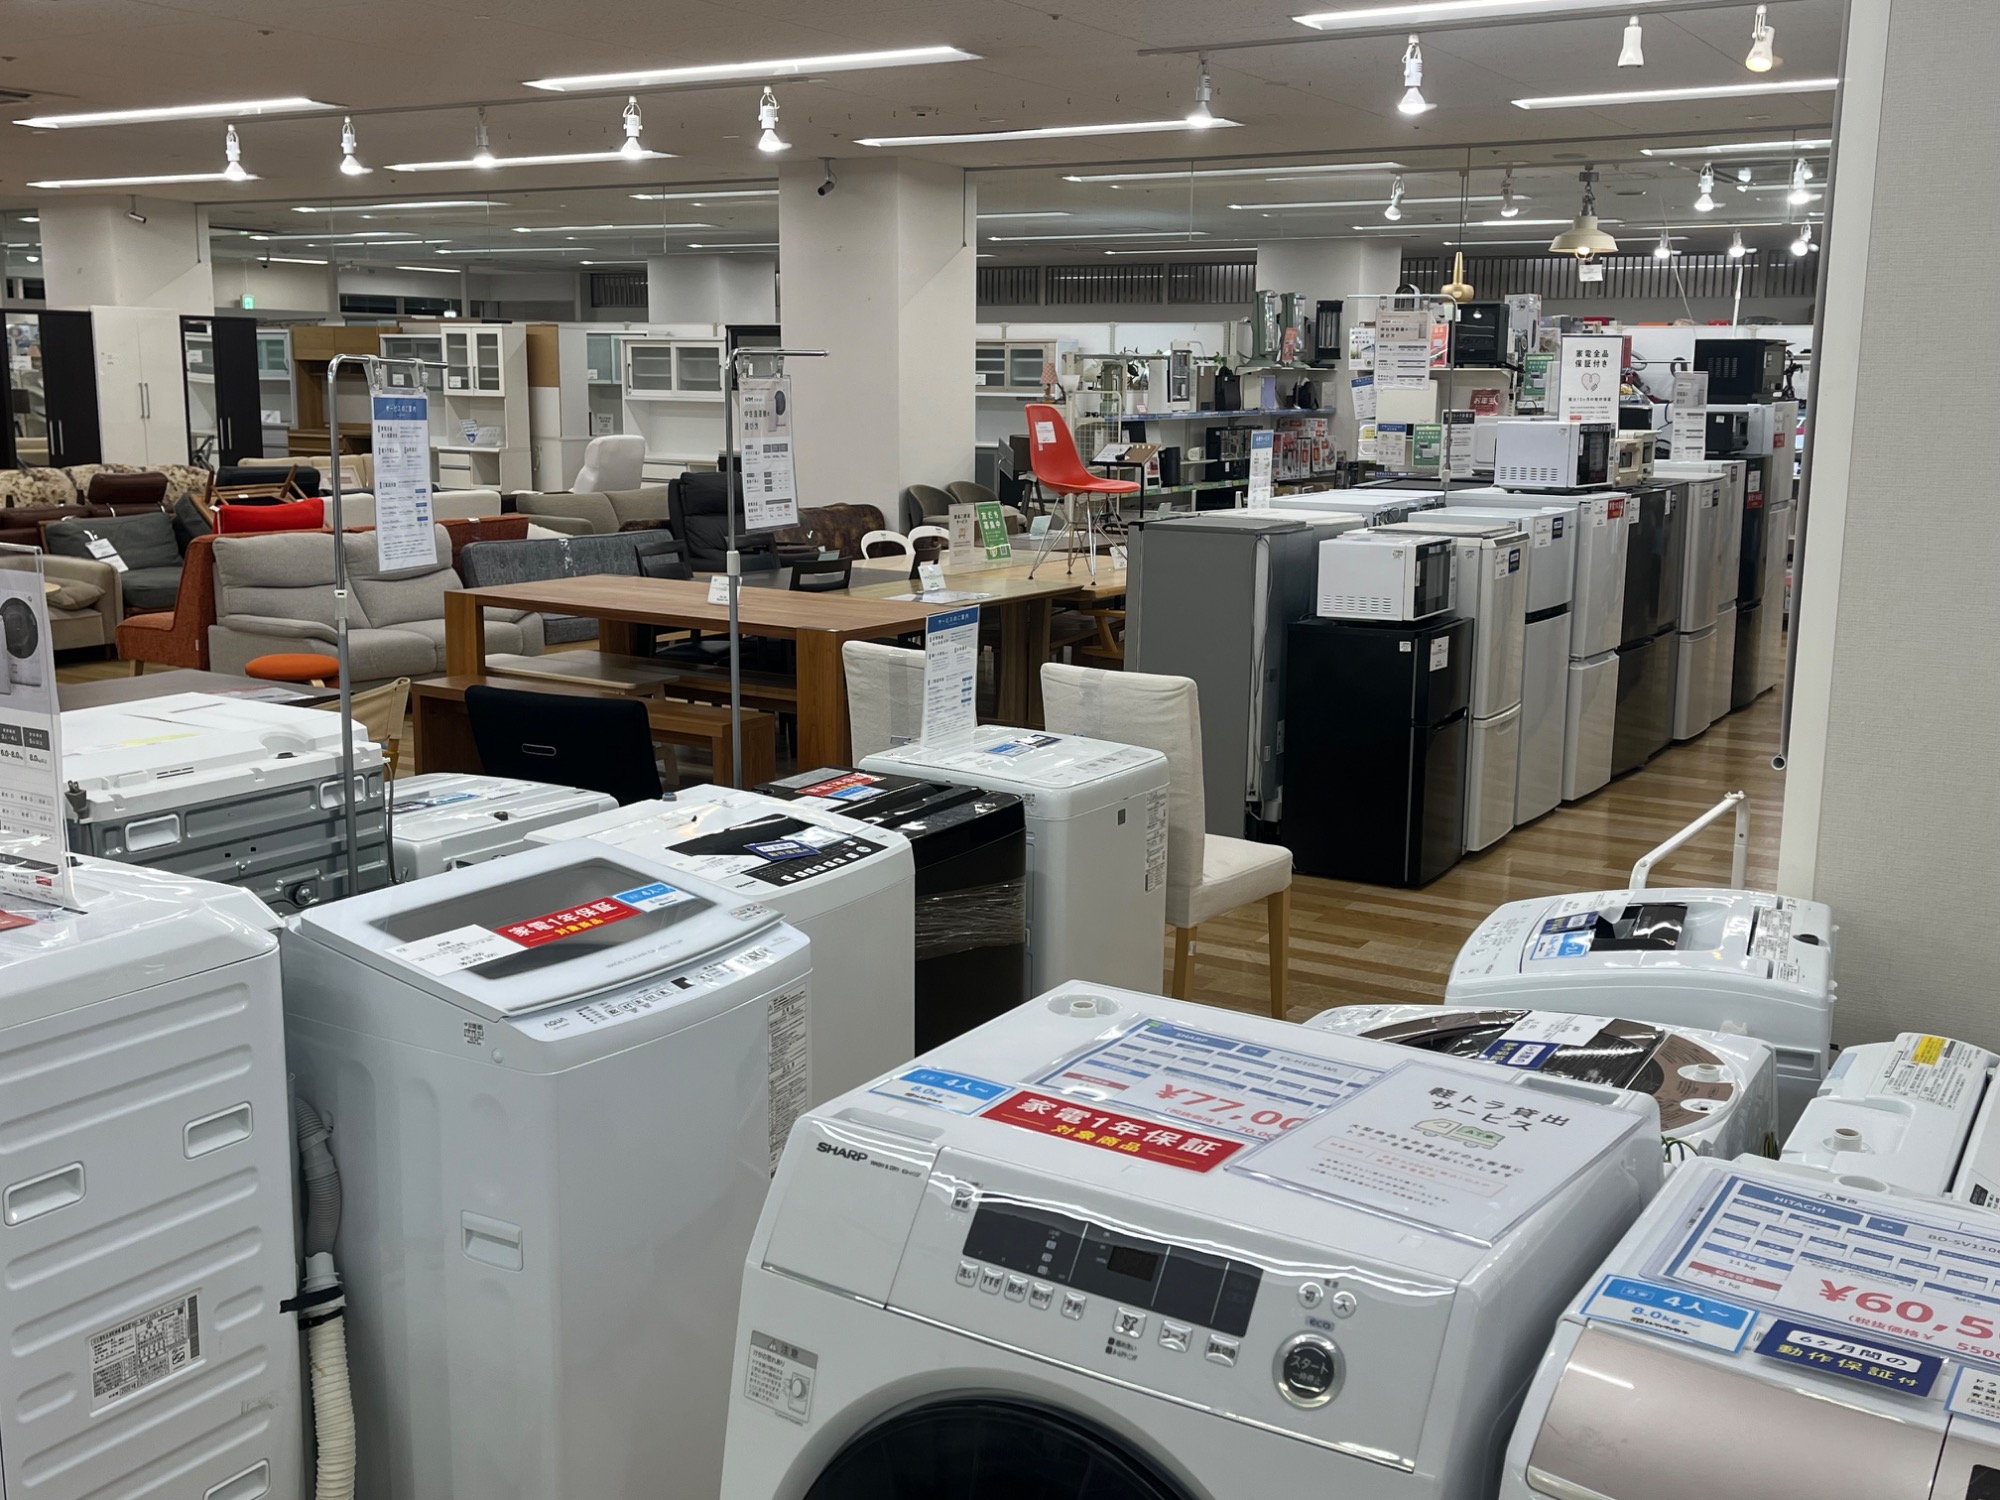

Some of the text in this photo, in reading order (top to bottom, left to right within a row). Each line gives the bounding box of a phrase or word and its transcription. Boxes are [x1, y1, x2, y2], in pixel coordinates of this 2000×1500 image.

[1575, 360, 1608, 368] 保証付き
[1576, 350, 1609, 358] 家電全品
[981, 511, 999, 520] 友だち
[983, 521, 1001, 530] 募集中
[507, 901, 618, 938] 家電1年保証
[554, 917, 603, 935] 対象商品
[1428, 1087, 1570, 1126] 軽トラ貸出
[1431, 1101, 1533, 1132] サービス
[1016, 1098, 1222, 1156] 家電1年保証
[1051, 1125, 1143, 1153] 対象商品
[816, 1142, 868, 1162] SHARP
[1773, 1195, 1826, 1214] HITACHI
[959, 1267, 976, 1280] 洗い
[982, 1276, 1001, 1288] すすぎ
[1007, 1282, 1025, 1295] 脱水
[1632, 1306, 1700, 1327] 8.0kg～
[1663, 1295, 1729, 1318] 4人～
[1819, 1279, 2000, 1341] ¥60,5
[1162, 1327, 1188, 1344] コース
[1290, 1355, 1328, 1375] スタート
[1777, 1344, 1919, 1388] 動作保証付
